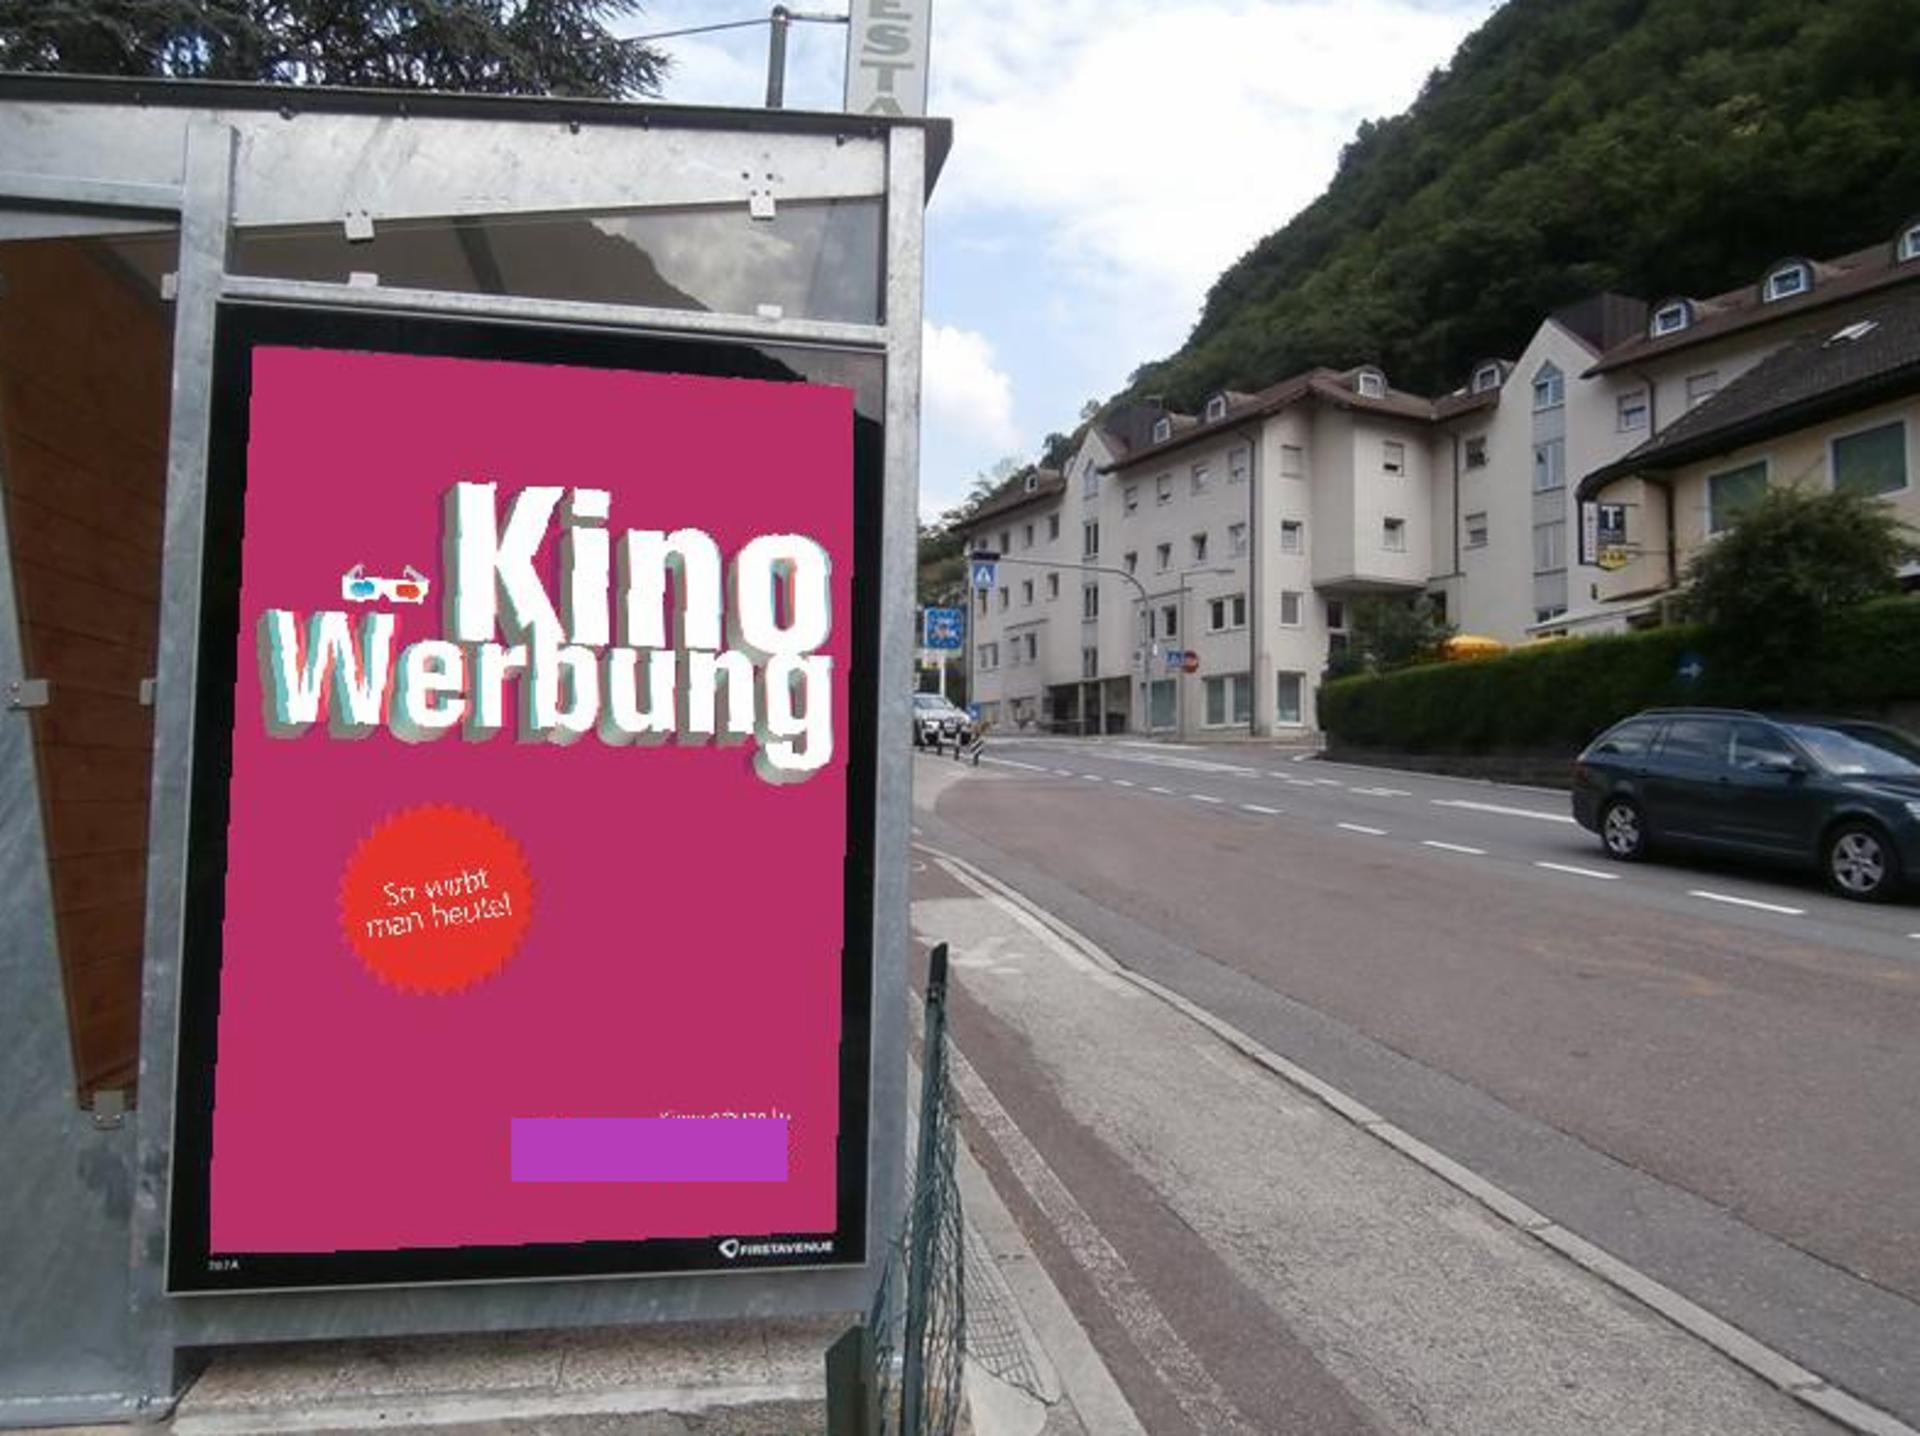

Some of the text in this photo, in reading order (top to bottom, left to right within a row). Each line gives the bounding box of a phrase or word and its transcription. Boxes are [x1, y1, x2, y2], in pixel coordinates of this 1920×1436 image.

[443, 481, 832, 656] Kino
[258, 609, 834, 784] Werbung
[365, 911, 425, 939] man
[383, 881, 417, 907] So
